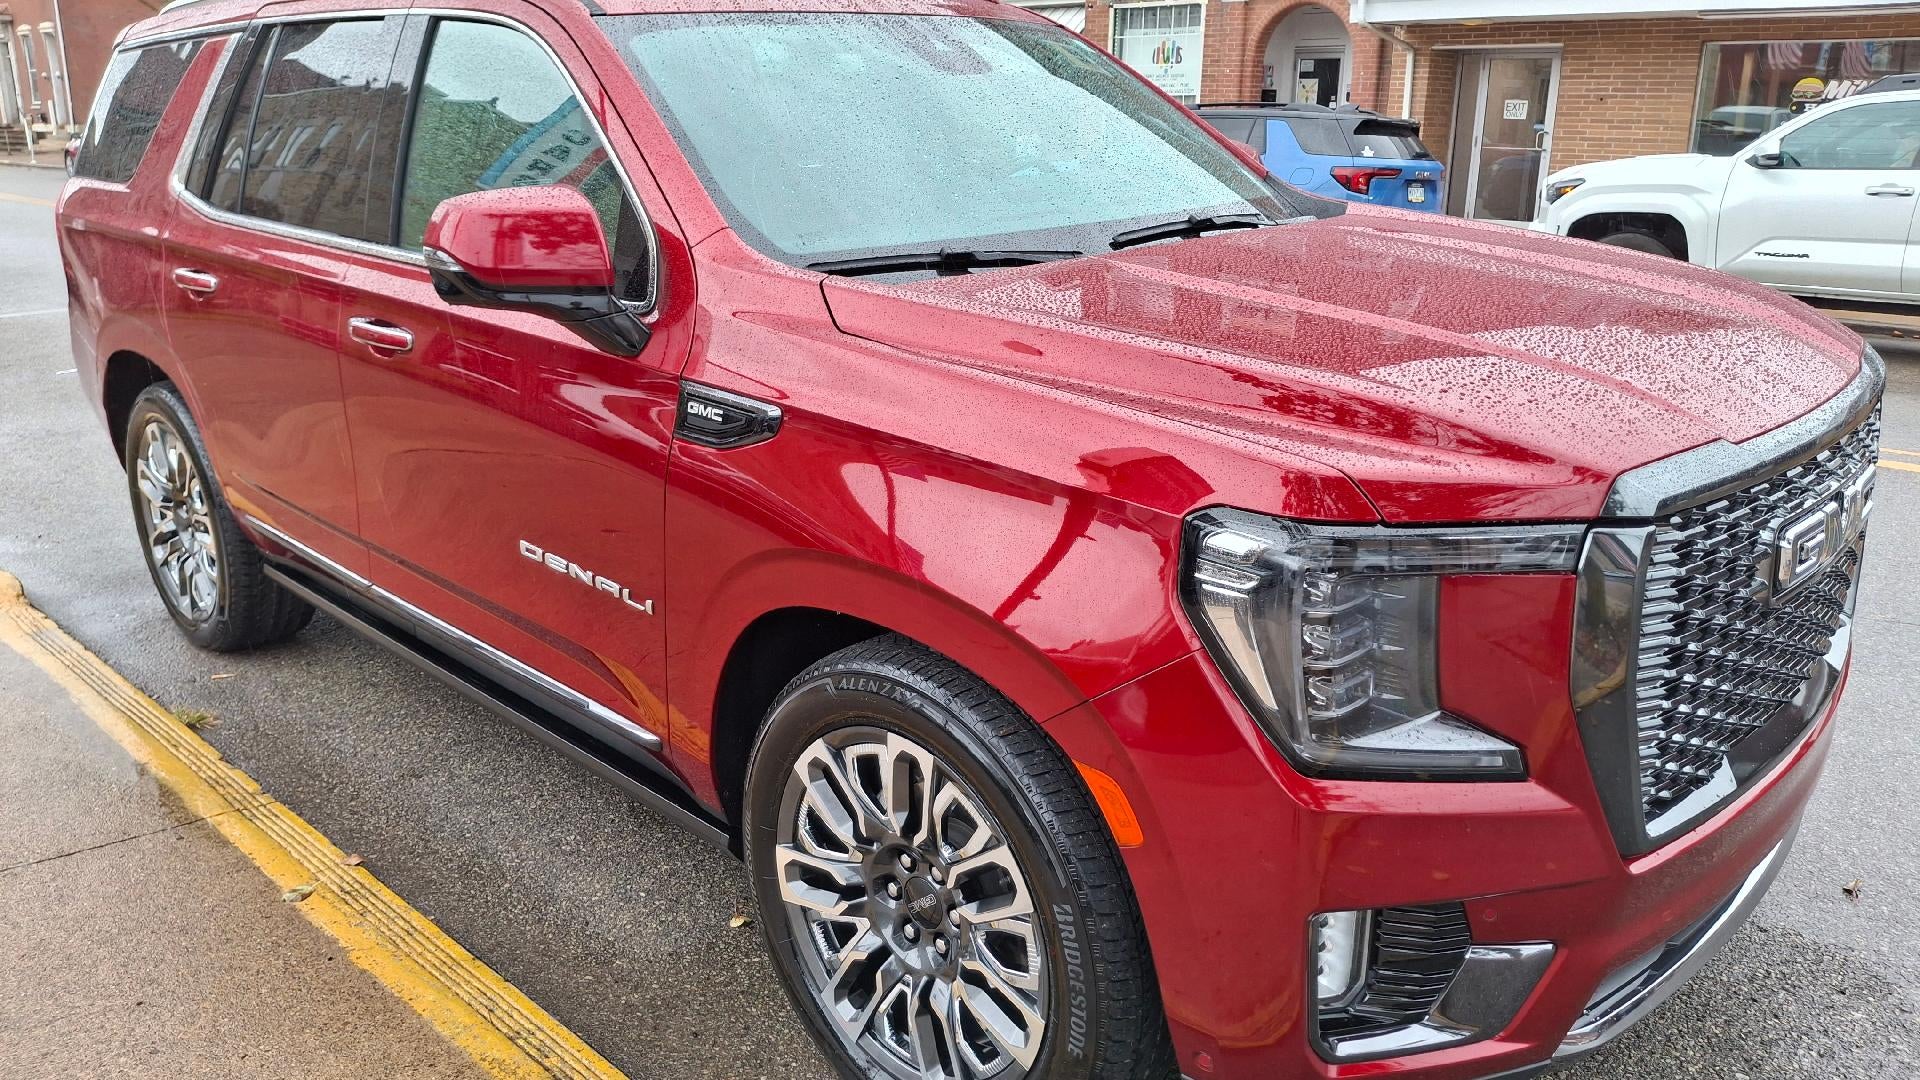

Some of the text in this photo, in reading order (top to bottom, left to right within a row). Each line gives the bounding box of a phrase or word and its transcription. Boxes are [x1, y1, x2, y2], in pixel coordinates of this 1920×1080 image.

[1506, 102, 1527, 111] EXIT
[1754, 251, 1810, 259] TACOMA
[687, 401, 724, 422] GMC
[519, 539, 654, 616] DENALI
[838, 677, 906, 701] ALENZA
[1052, 903, 1088, 1060] BRIDGESTONE
